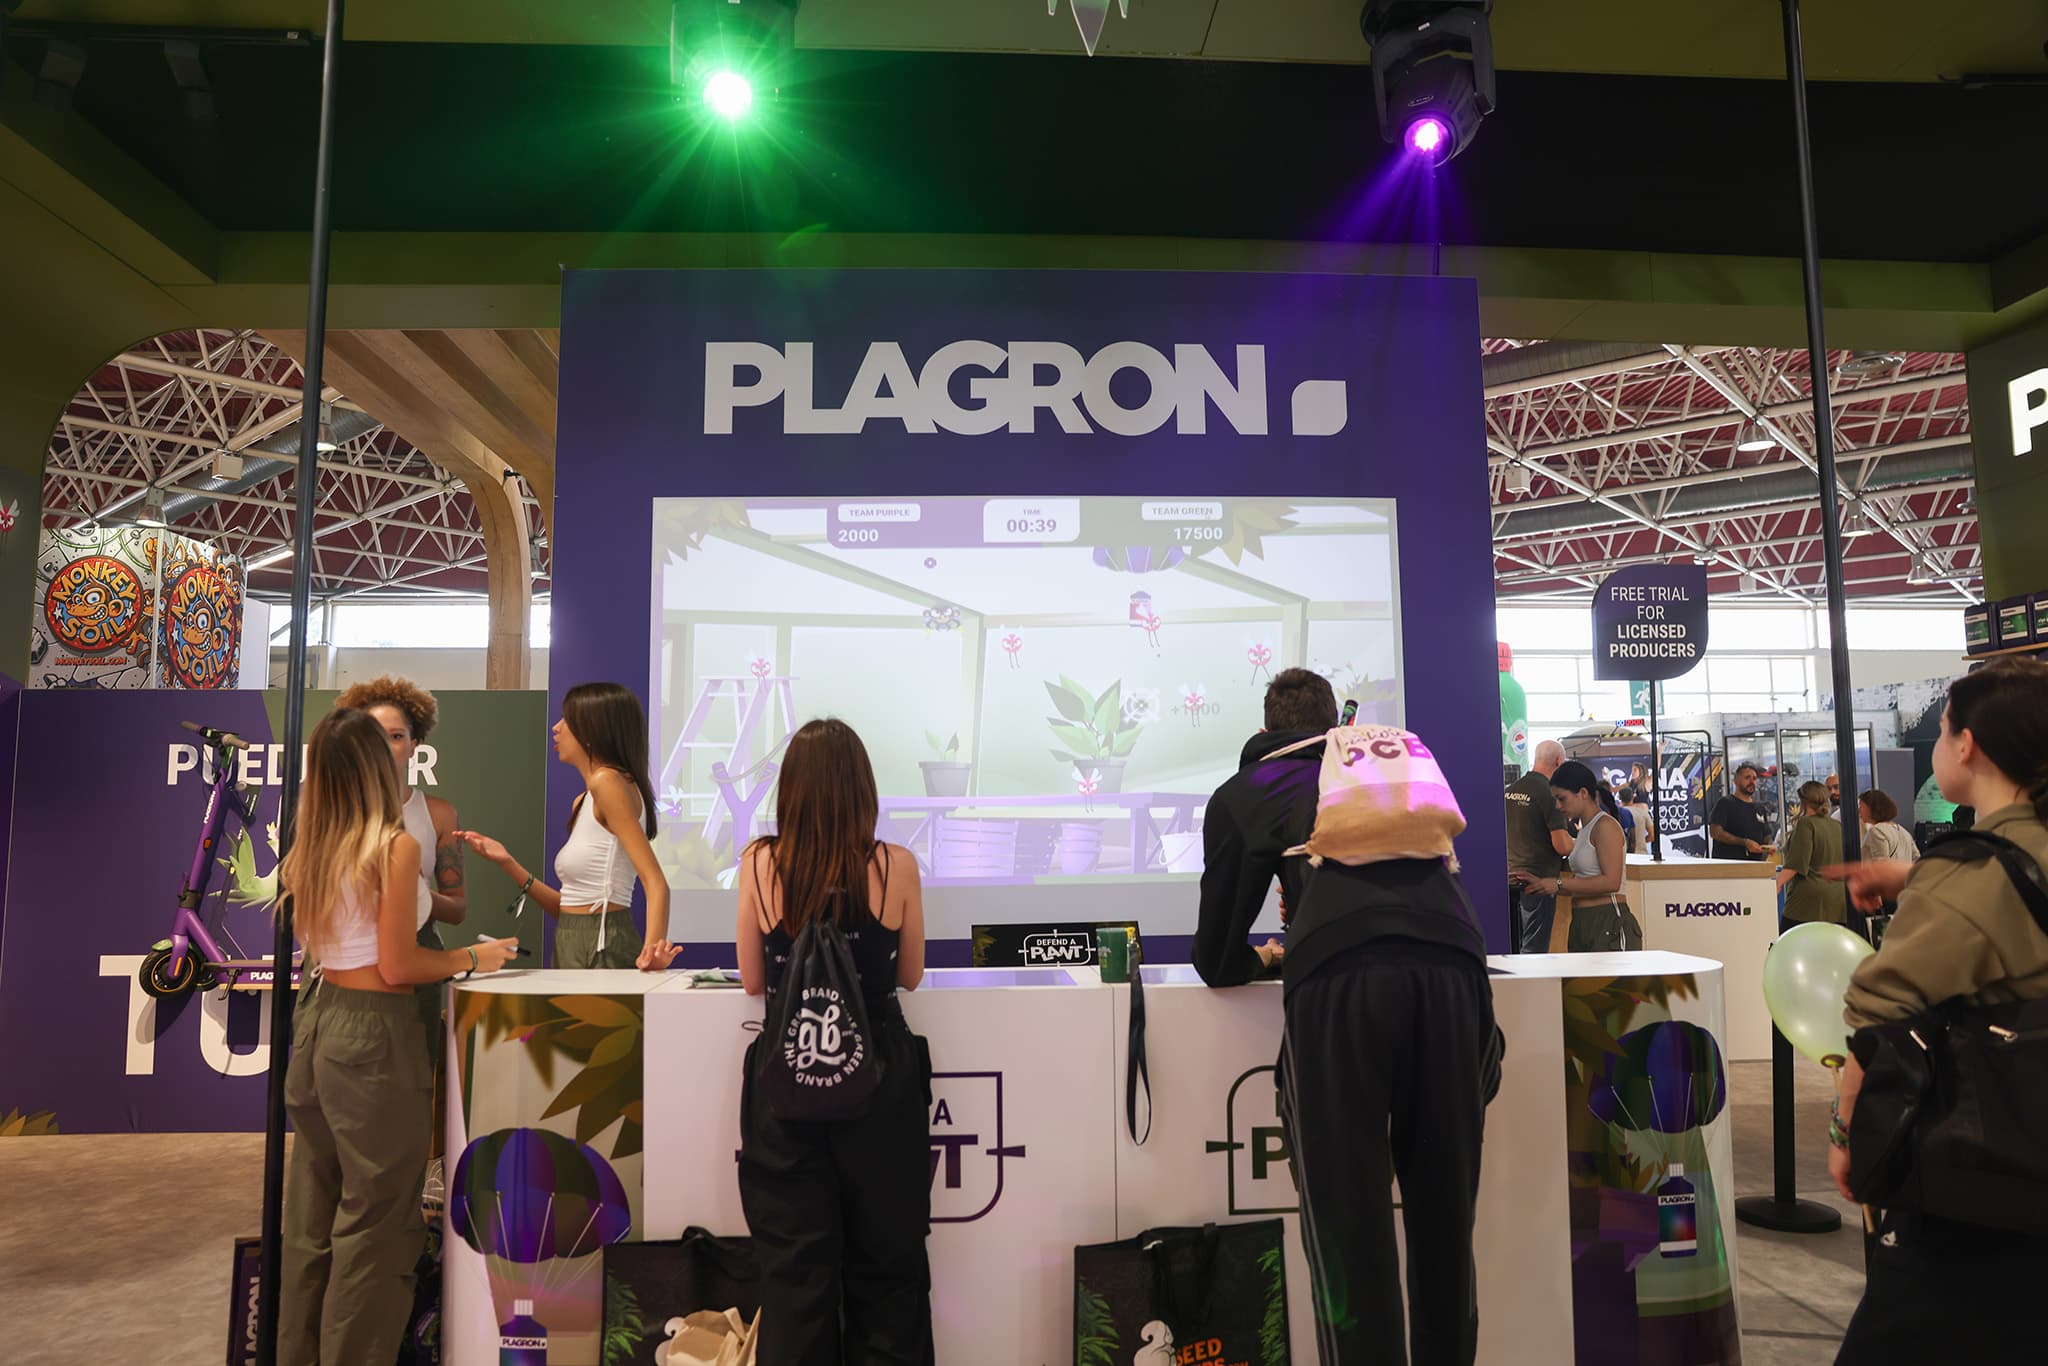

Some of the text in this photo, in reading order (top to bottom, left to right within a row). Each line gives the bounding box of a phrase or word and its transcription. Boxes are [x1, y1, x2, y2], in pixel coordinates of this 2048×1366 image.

[704, 340, 1268, 435] PLAGRON
[849, 508, 910, 516] TEAM PURPLE
[1152, 506, 1213, 515] TEAM GREEN
[1007, 519, 1057, 533] 00:39
[1174, 527, 1224, 540] 17500
[838, 528, 879, 542] 2000
[53, 561, 136, 601] MONKEY
[1611, 586, 1689, 601] FREE TRIAL
[171, 572, 232, 633] MONKEY
[1637, 605, 1665, 620] FOR
[61, 617, 127, 644] SOIL
[1617, 624, 1686, 639] LICENSED
[1609, 643, 1696, 658] PRODUCERS
[177, 644, 224, 681] SOIL
[1665, 902, 1742, 918] PLAGRON
[1036, 938, 1068, 946] DEFEND
[1030, 945, 1083, 962] PLANT
[795, 1072, 842, 1087] BRAND
